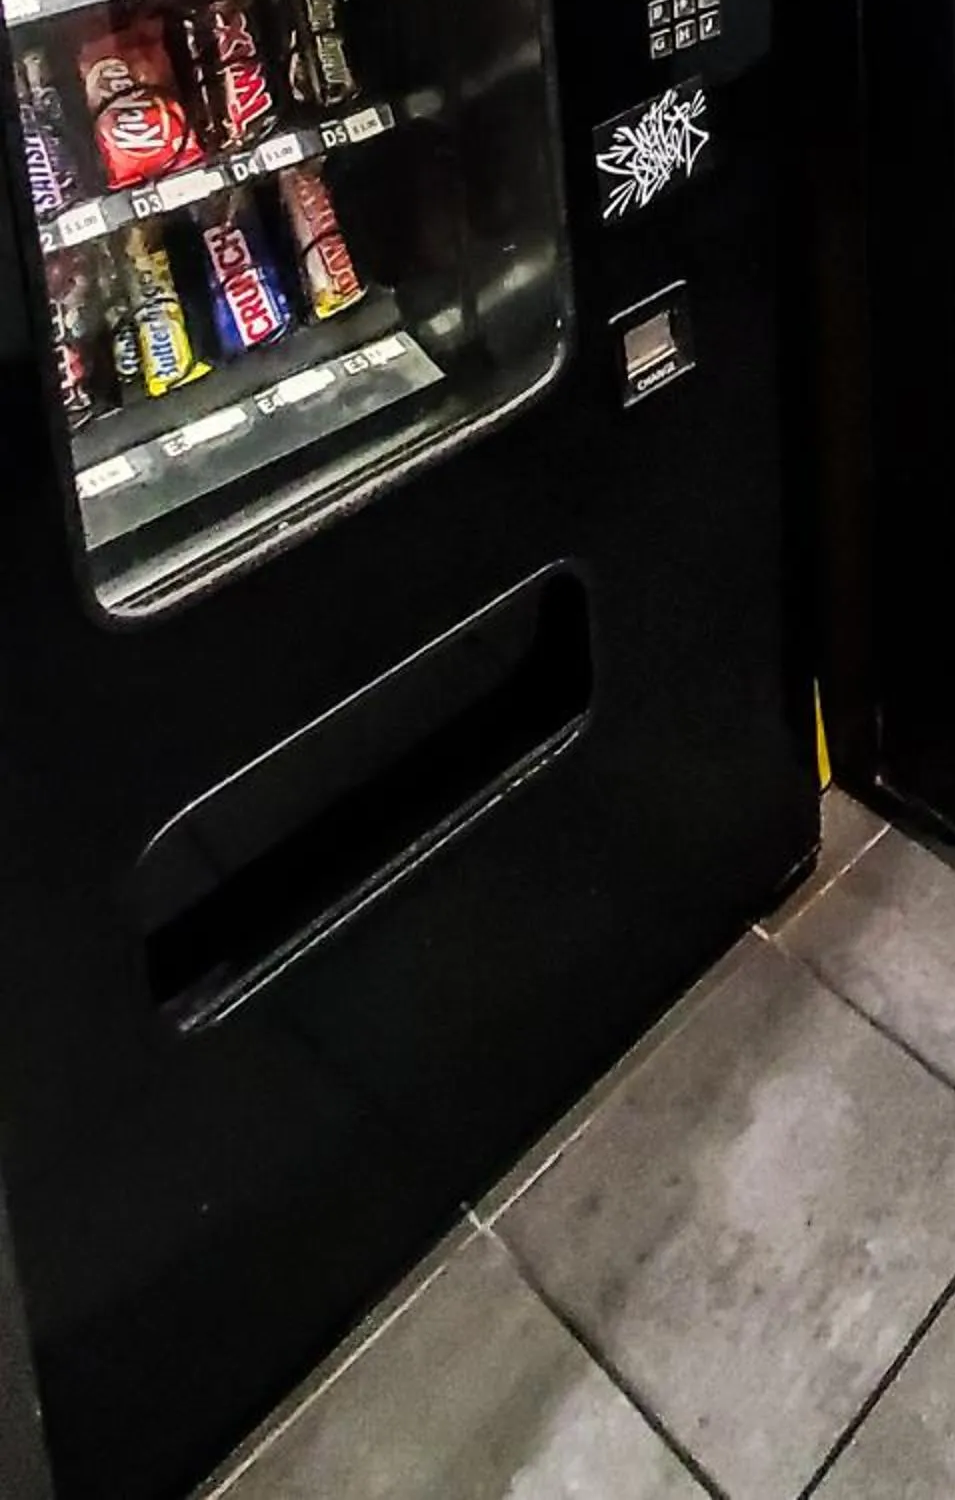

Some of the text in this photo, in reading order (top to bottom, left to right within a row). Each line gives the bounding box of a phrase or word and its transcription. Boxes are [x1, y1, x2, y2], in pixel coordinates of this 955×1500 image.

[321, 125, 347, 149] D5
[232, 158, 260, 182] D4
[134, 195, 164, 219] D3
